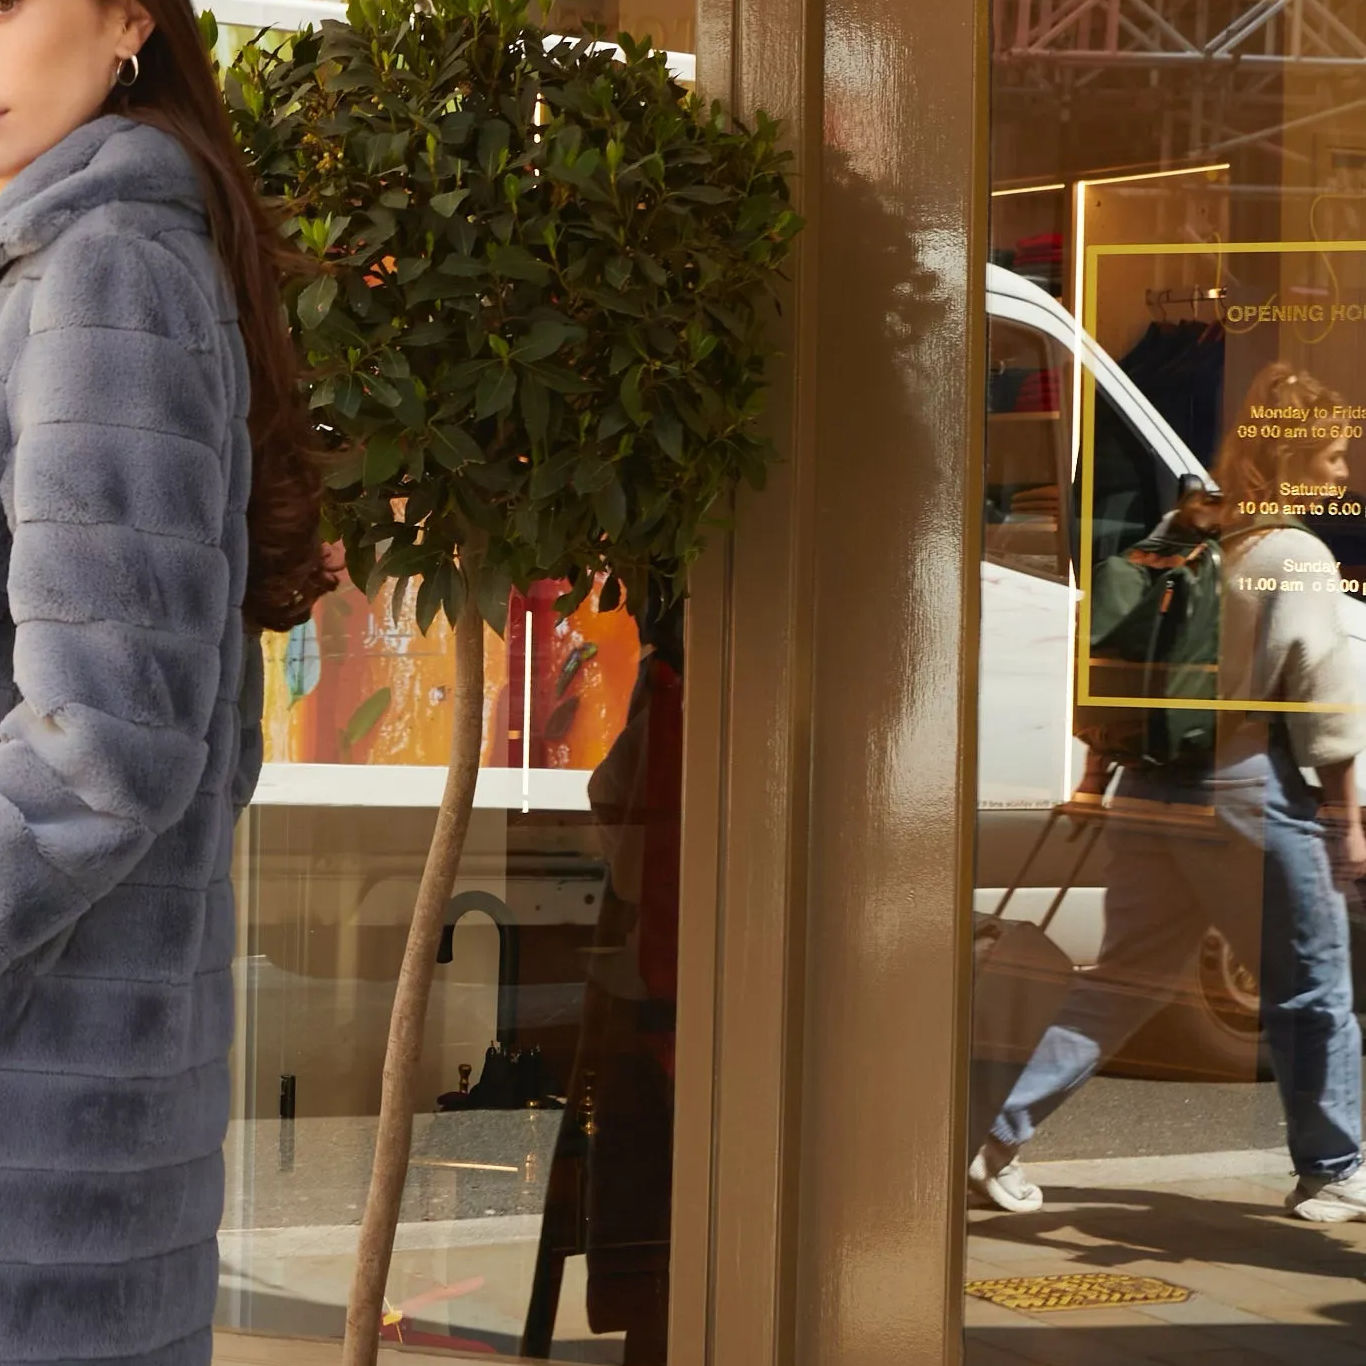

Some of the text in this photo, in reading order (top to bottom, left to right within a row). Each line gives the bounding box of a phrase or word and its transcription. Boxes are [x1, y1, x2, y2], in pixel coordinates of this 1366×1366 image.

[1226, 304, 1366, 322] OPENING HO
[1250, 405, 1310, 422] Monday
[1314, 406, 1328, 419] to
[1284, 427, 1308, 438] am
[1311, 426, 1327, 438] to
[1330, 424, 1363, 439] 6.00
[1279, 482, 1347, 499] Saturday
[1282, 504, 1306, 515] am
[1309, 502, 1324, 516] to
[1328, 502, 1361, 516] 6.00
[1283, 559, 1341, 575] Sunday
[1237, 577, 1277, 591] 11.00
[1280, 580, 1303, 592] am
[1326, 579, 1359, 593] 5.00
